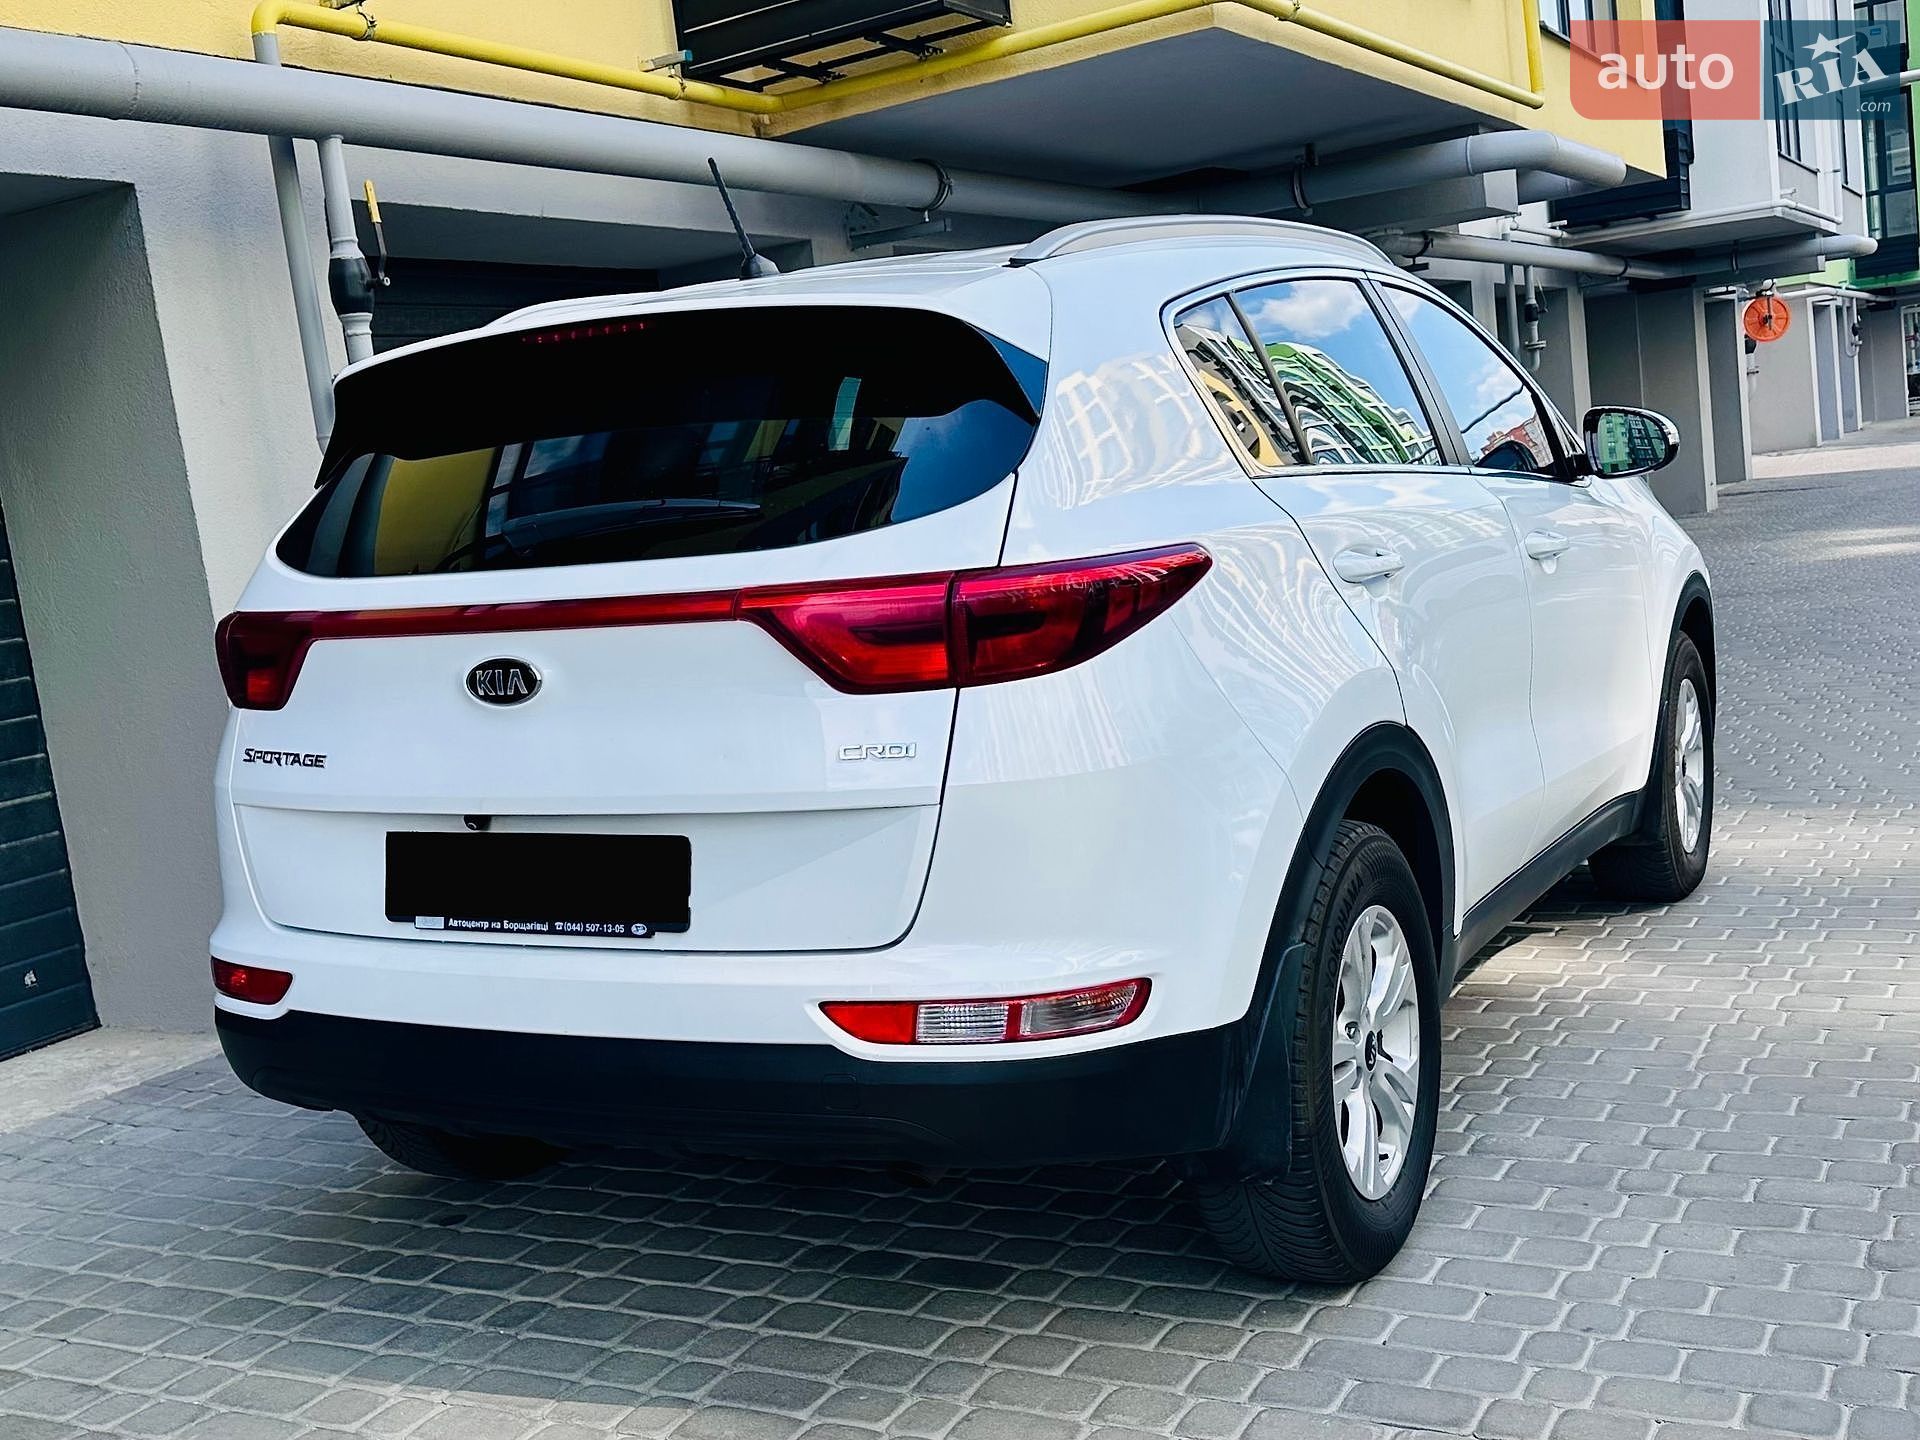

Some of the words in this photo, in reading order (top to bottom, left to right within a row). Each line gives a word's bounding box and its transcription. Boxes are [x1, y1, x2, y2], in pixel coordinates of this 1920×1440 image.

[475, 668, 529, 696] KIA
[243, 748, 328, 769] SPORTAGE
[448, 917, 490, 931] Автоцентр
[491, 921, 501, 929] на
[564, 921, 584, 933] (044)
[586, 923, 625, 934] 507-13-05
